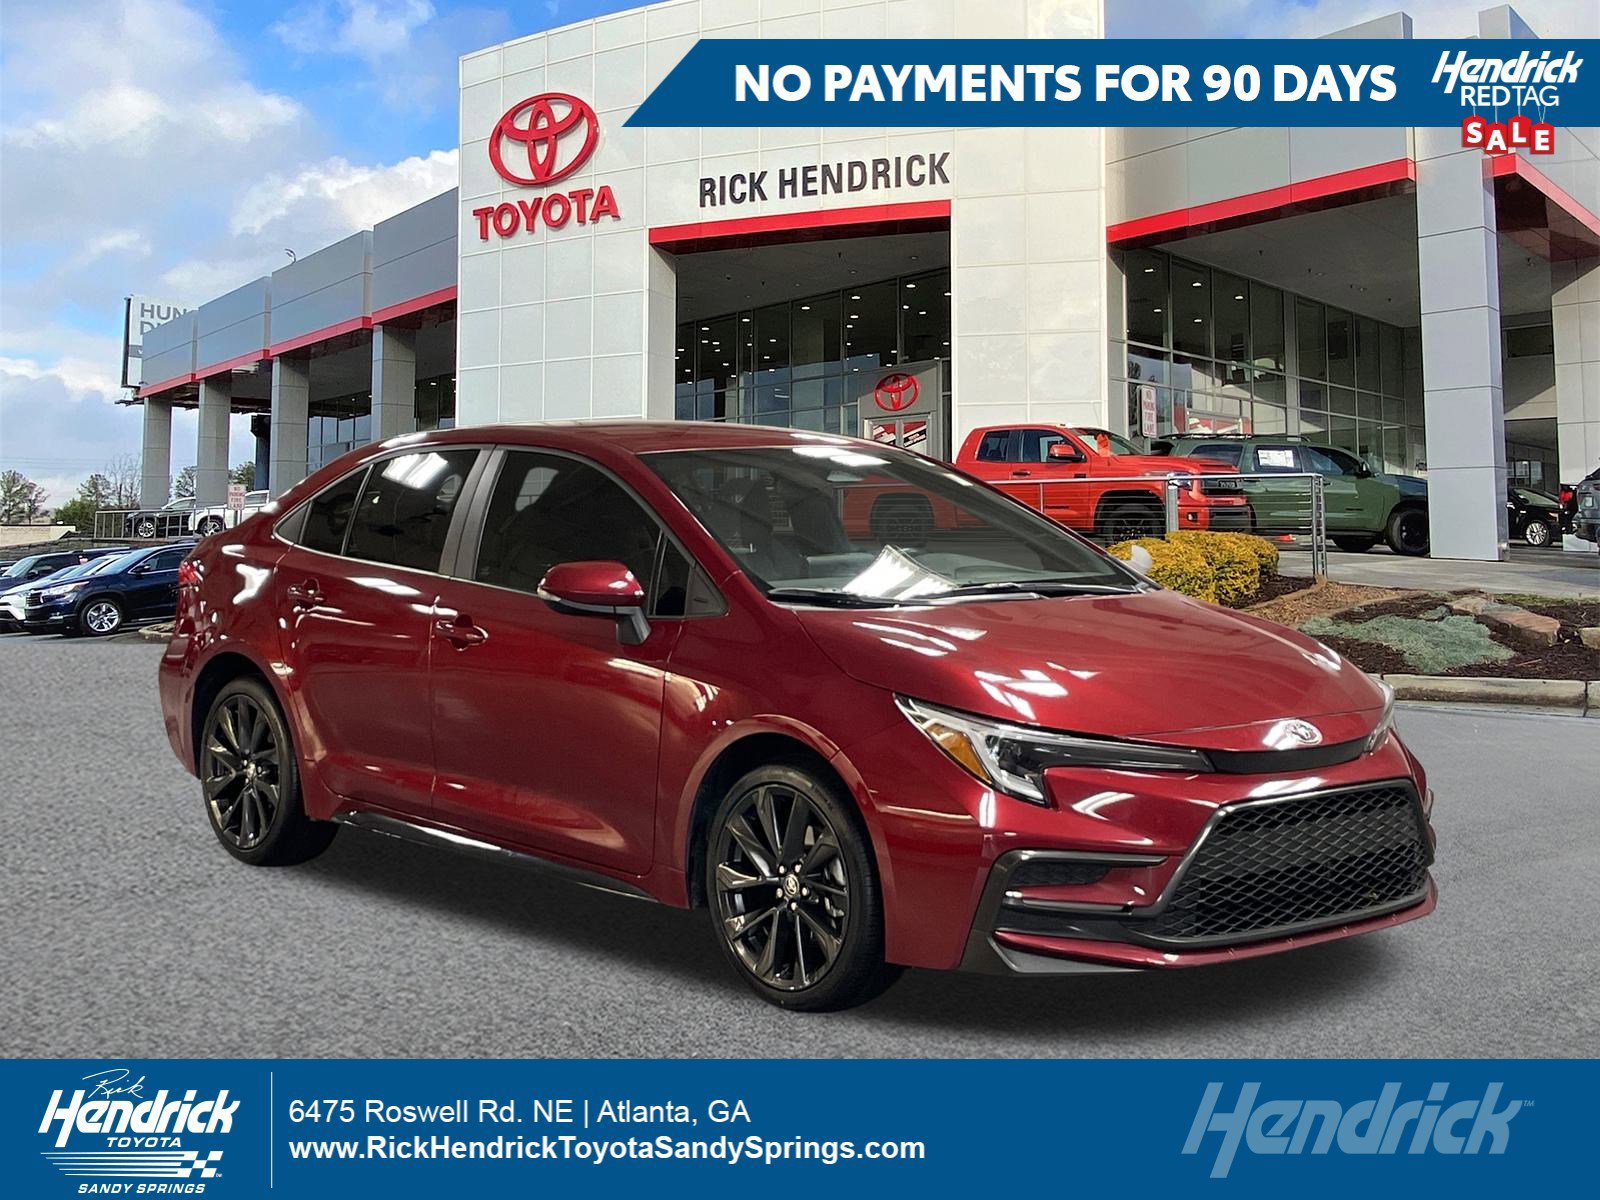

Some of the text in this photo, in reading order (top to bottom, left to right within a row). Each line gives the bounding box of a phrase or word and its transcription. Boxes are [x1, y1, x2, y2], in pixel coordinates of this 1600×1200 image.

[699, 152, 950, 207] RICK HENDRICK
[472, 185, 620, 240] TOYOTA
